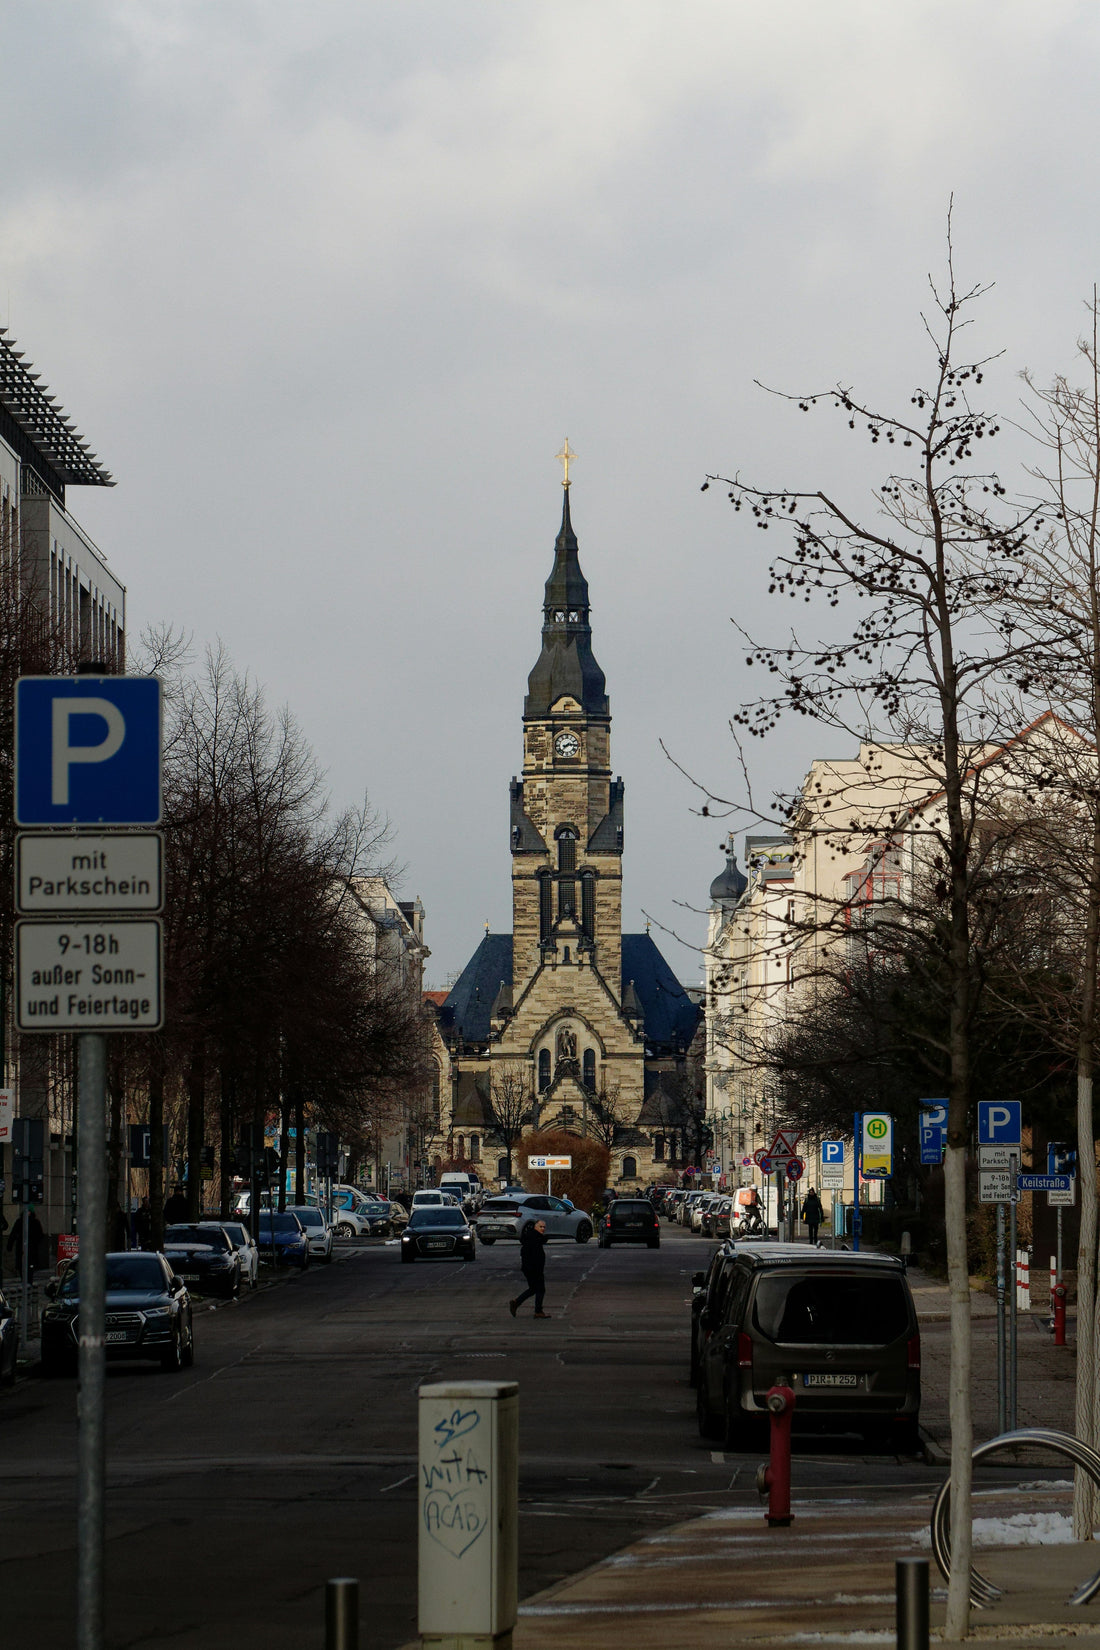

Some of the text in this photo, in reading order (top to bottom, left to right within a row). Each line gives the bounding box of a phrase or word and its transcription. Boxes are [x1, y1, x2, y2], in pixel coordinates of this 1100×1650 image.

[51, 697, 126, 805] P
[71, 850, 107, 871] mit
[29, 876, 150, 897] Parkschein
[57, 934, 119, 956] 9-18h
[31, 965, 146, 986] außer Sonn-
[27, 995, 151, 1020] und Feiertage
[872, 1123, 882, 1134] H
[989, 1107, 1011, 1139] P
[924, 1129, 933, 1145] P
[827, 1144, 840, 1161] P
[1022, 1177, 1066, 1188] Keilstraße
[982, 1191, 992, 1199] und
[810, 1375, 826, 1384] PIR
[839, 1375, 856, 1384] 252
[426, 1501, 480, 1532] ACAB
